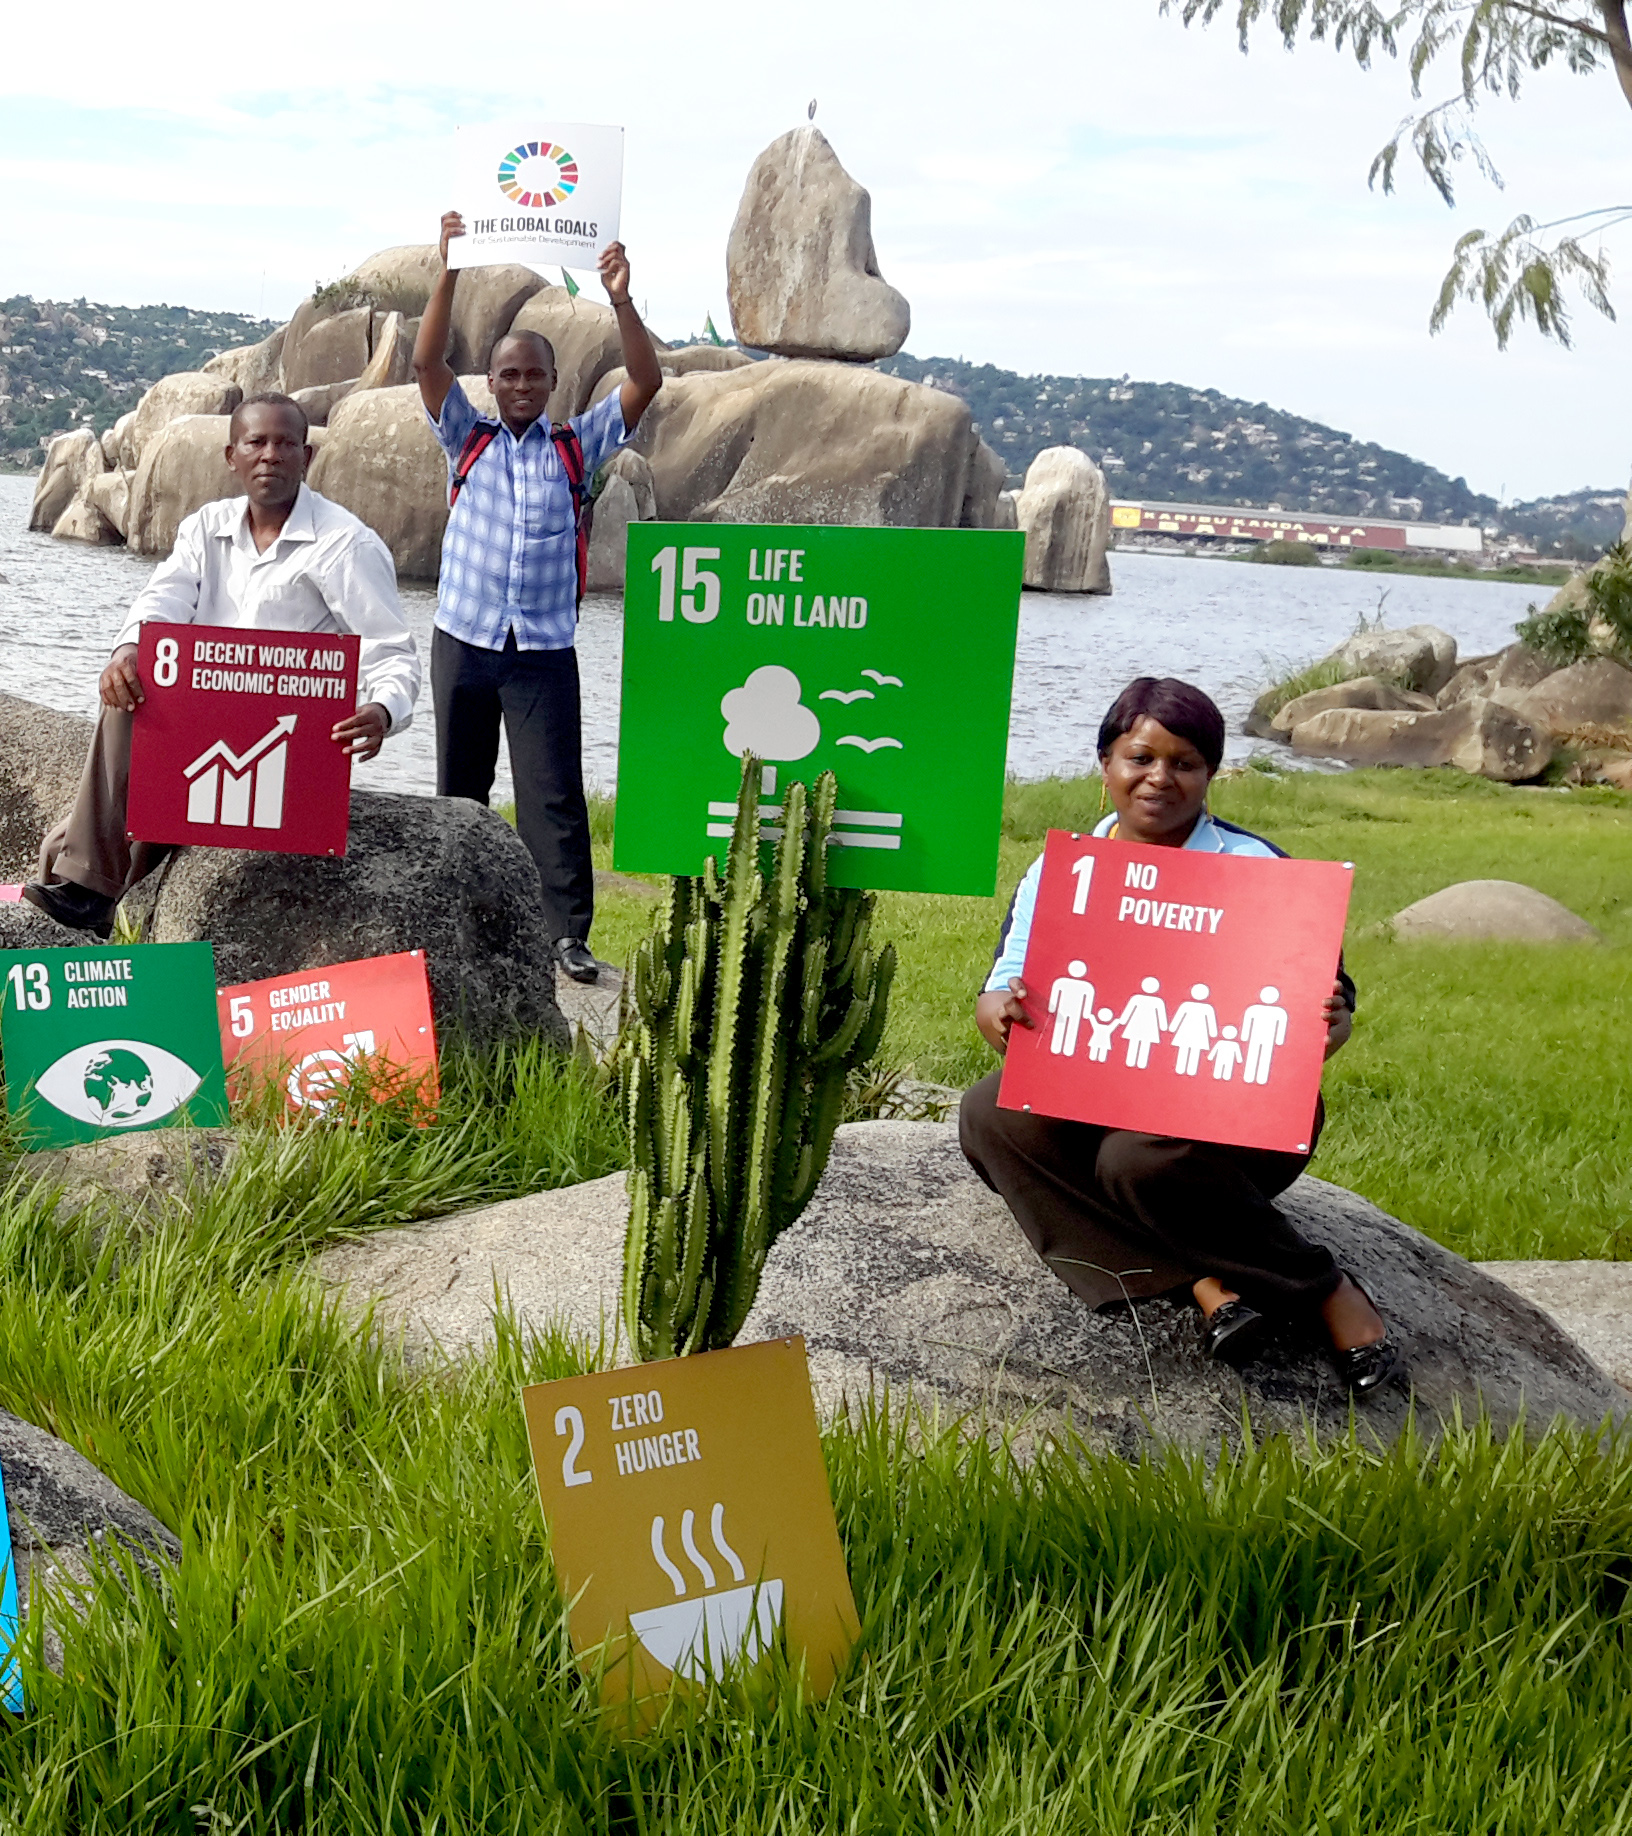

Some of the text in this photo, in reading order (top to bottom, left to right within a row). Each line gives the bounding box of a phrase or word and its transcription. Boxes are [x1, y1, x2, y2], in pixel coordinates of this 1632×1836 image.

[472, 235, 596, 250] For Sustainable Development
[473, 217, 598, 238] THE GLOBAL GOALS
[1143, 511, 1228, 525] KARIBU
[1158, 521, 1351, 545] BALIMI
[748, 548, 804, 583] LIFE
[650, 546, 721, 624] 15
[745, 593, 867, 630] ON LAND
[153, 638, 179, 687] 8
[193, 641, 345, 671] DECENT WORK AND
[191, 668, 346, 700] ECONOMIC GROWTH
[1070, 854, 1096, 916] 1
[1123, 862, 1157, 890] NO
[1117, 896, 1223, 934] POVERTY
[7, 962, 51, 1011] 13
[64, 959, 133, 983] CLIMATE
[67, 986, 127, 1009] ACTION
[269, 981, 330, 1008] GENDER
[230, 996, 254, 1037] 5
[271, 1001, 346, 1031] EQUALITY
[608, 1390, 664, 1431] ZERO
[554, 1405, 592, 1487] 2
[614, 1428, 702, 1475] HUNGER
